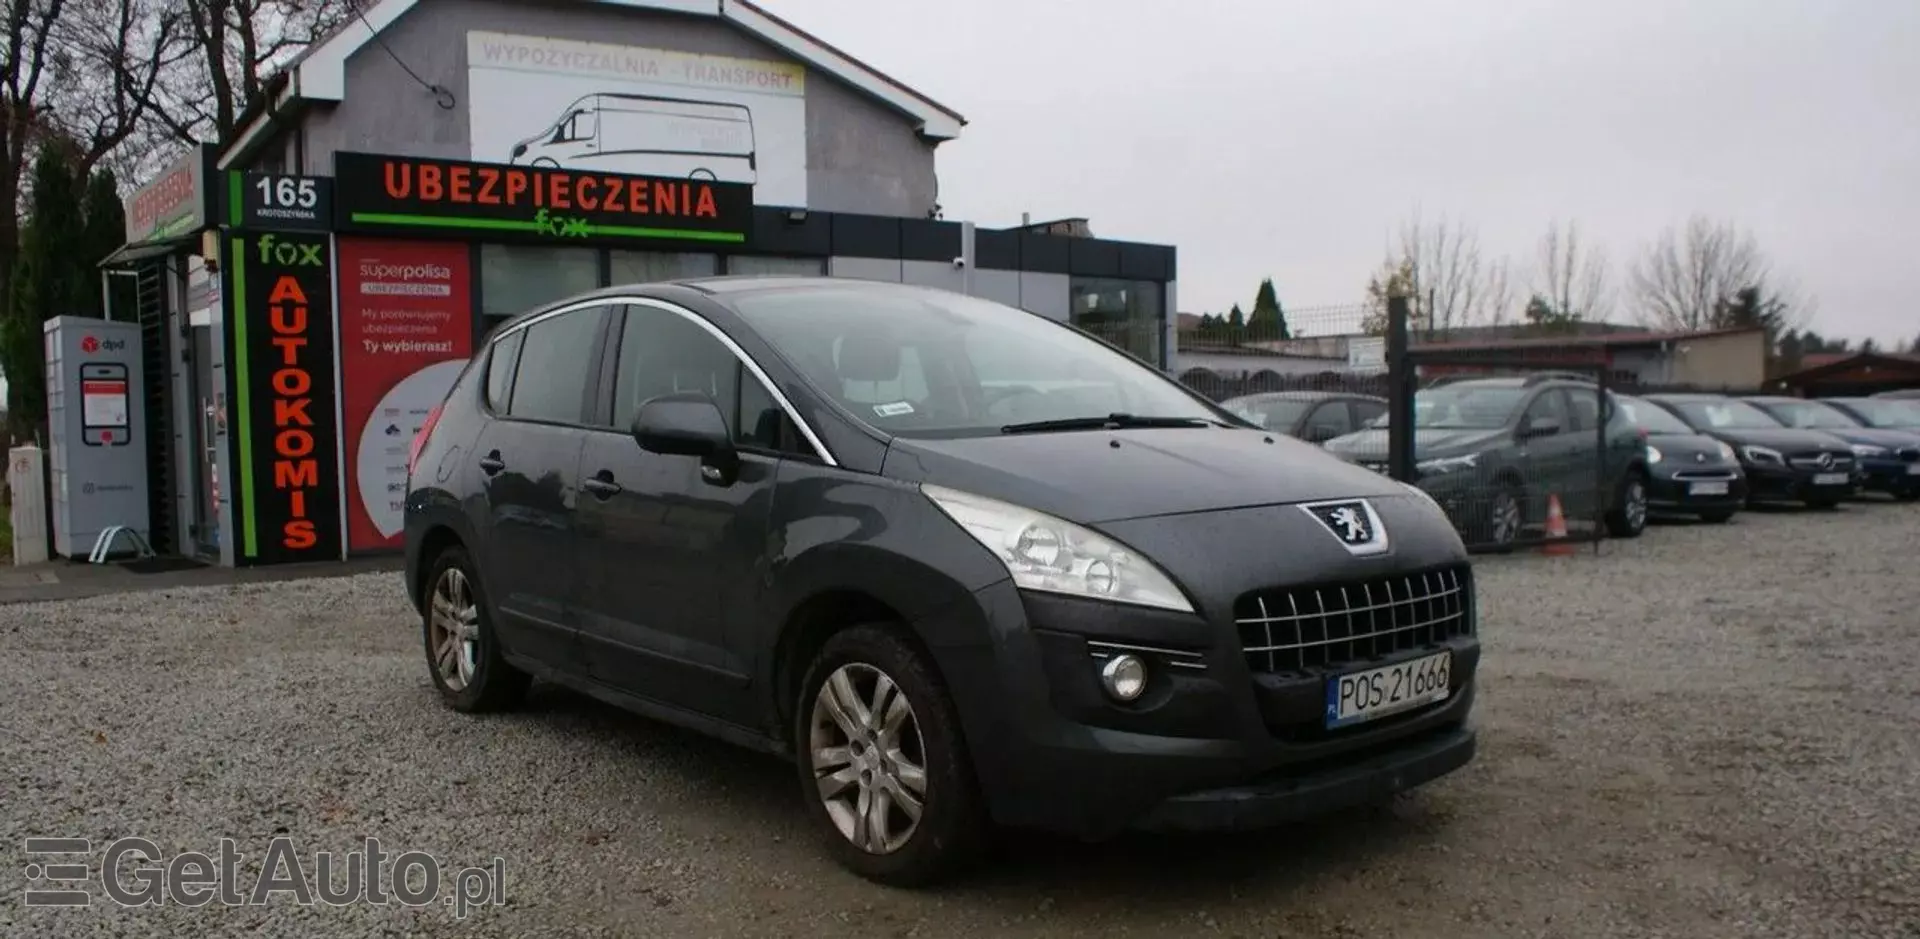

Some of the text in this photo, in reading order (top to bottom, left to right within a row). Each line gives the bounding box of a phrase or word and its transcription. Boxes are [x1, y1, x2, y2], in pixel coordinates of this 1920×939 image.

[683, 61, 793, 88] TRANSPORT
[256, 176, 317, 208] 165
[384, 162, 718, 217] UBEZPIECZENIA
[257, 233, 324, 266] fox
[360, 263, 451, 281] superpolisa
[362, 339, 452, 354] Ty wybierasz!
[268, 275, 319, 550] AUTOKOMIS
[1341, 655, 1448, 717] POS 21666
